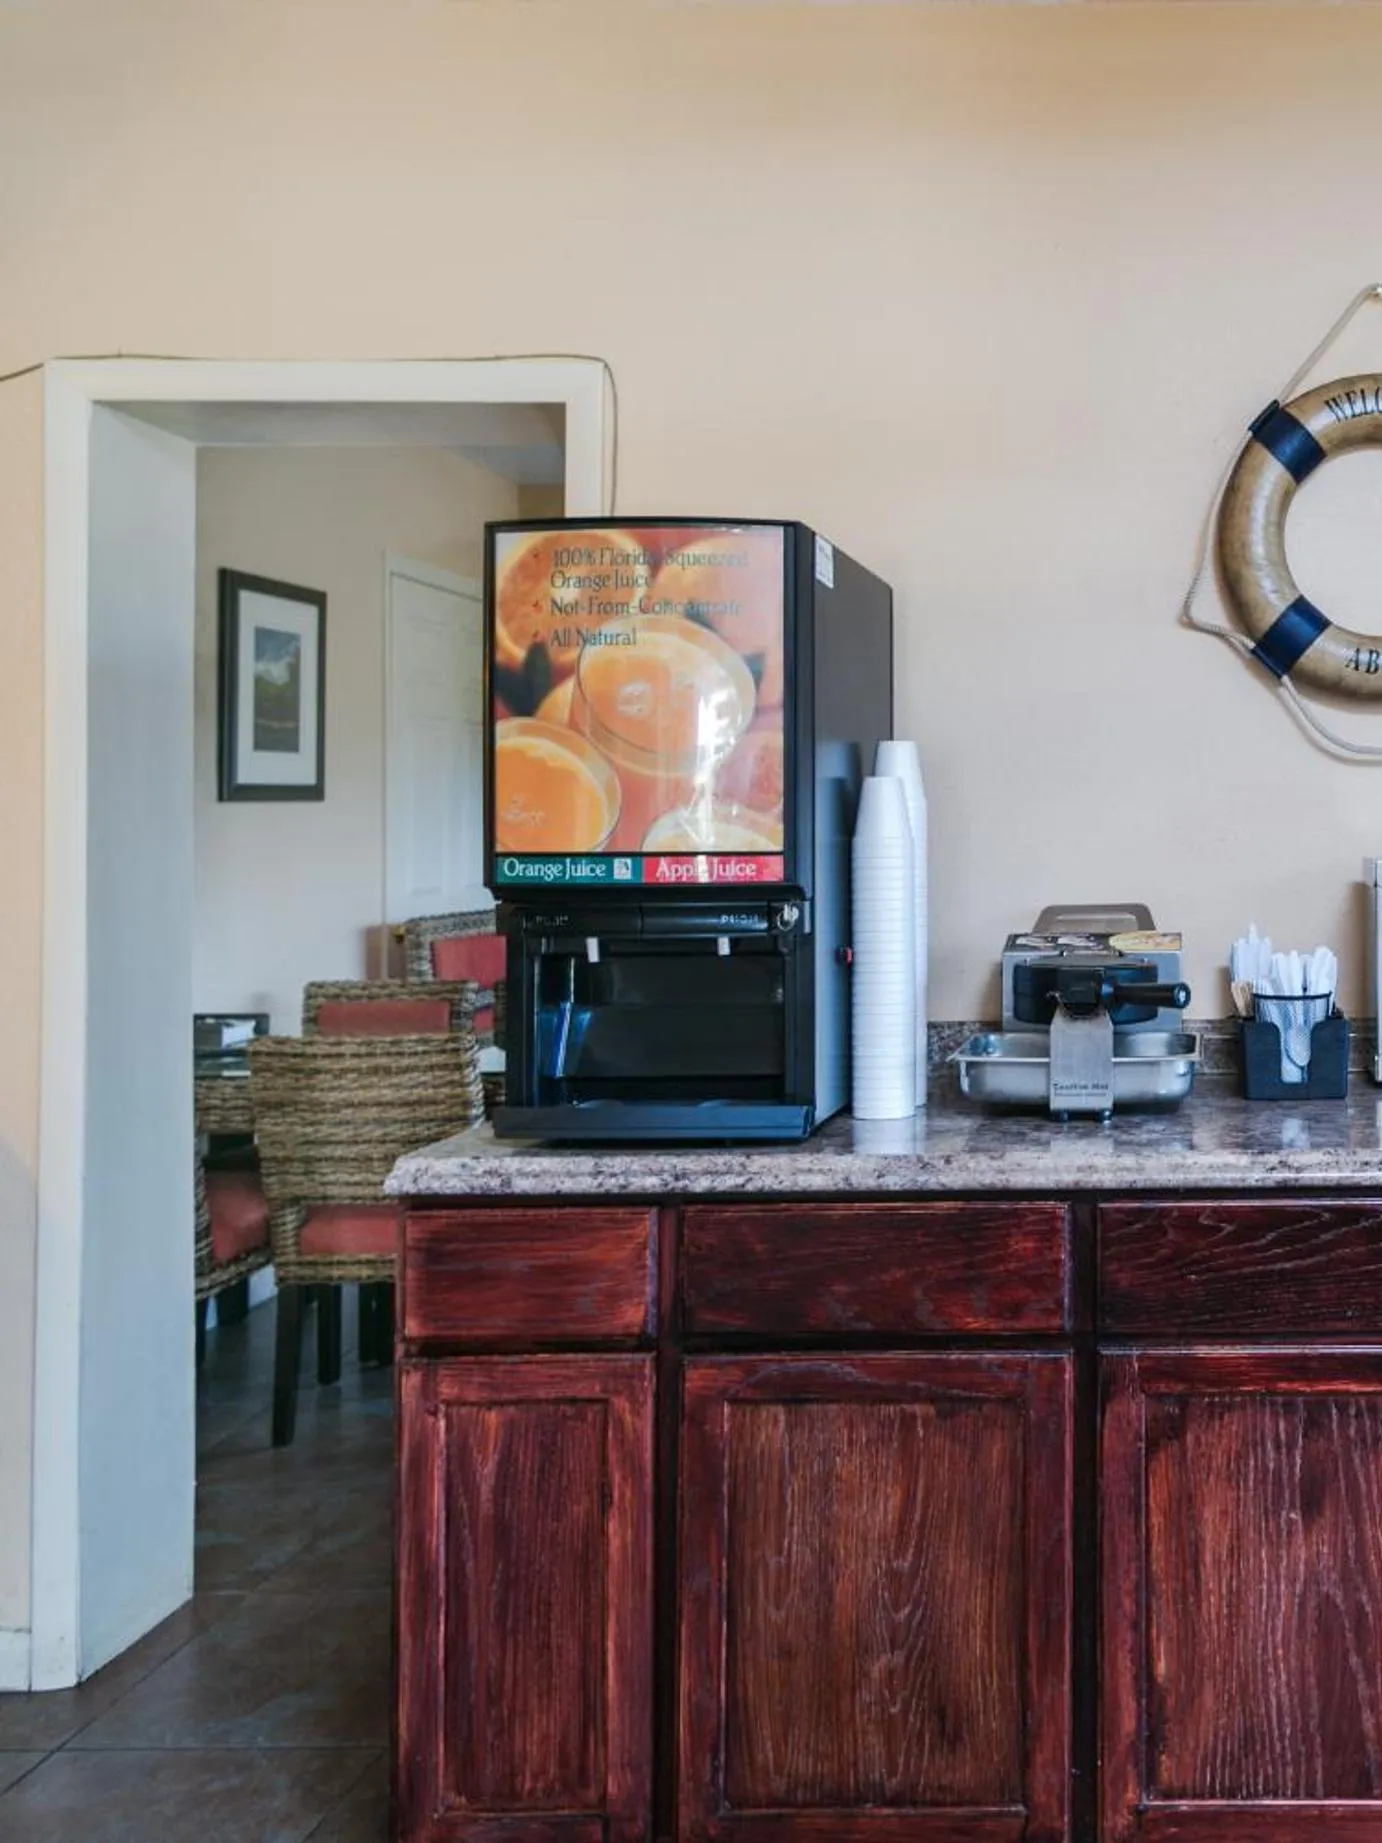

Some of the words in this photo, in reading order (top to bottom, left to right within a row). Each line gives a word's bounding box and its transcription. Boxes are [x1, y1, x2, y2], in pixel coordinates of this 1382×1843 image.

[550, 569, 611, 592] Orange
[613, 569, 653, 590] Juice
[551, 628, 571, 647] All
[576, 627, 637, 648] Natural
[503, 857, 563, 881] Orange
[565, 857, 607, 879] Juice
[655, 857, 708, 880] Appl
[711, 857, 757, 879] Juice
